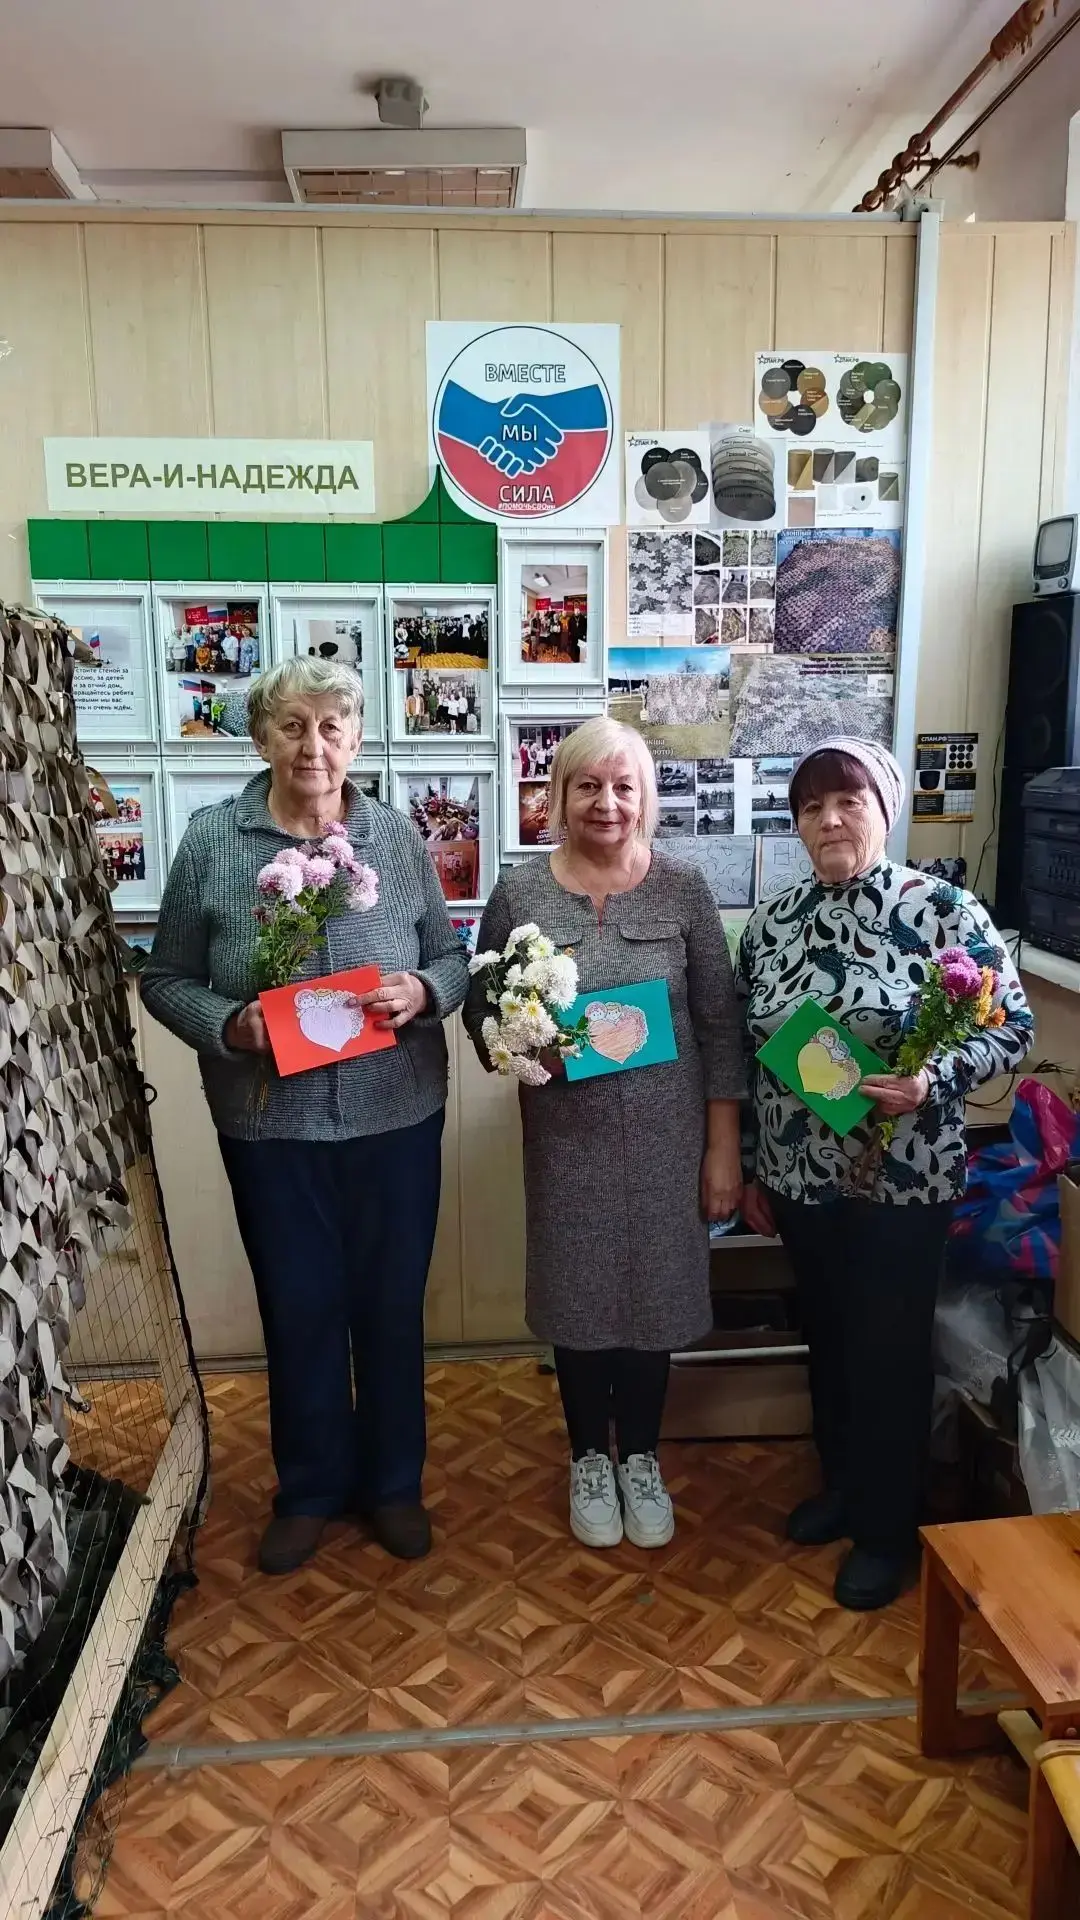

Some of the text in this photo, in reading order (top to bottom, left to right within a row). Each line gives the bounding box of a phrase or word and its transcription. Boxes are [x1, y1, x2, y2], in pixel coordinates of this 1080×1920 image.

[484, 363, 566, 383] ВМЕСТЕ
[502, 424, 538, 442] МЫ
[65, 463, 360, 494] ВЕРА-И-НАДЕЖДА
[499, 484, 556, 503] СИЛА
[652, 747, 674, 757] лото)
